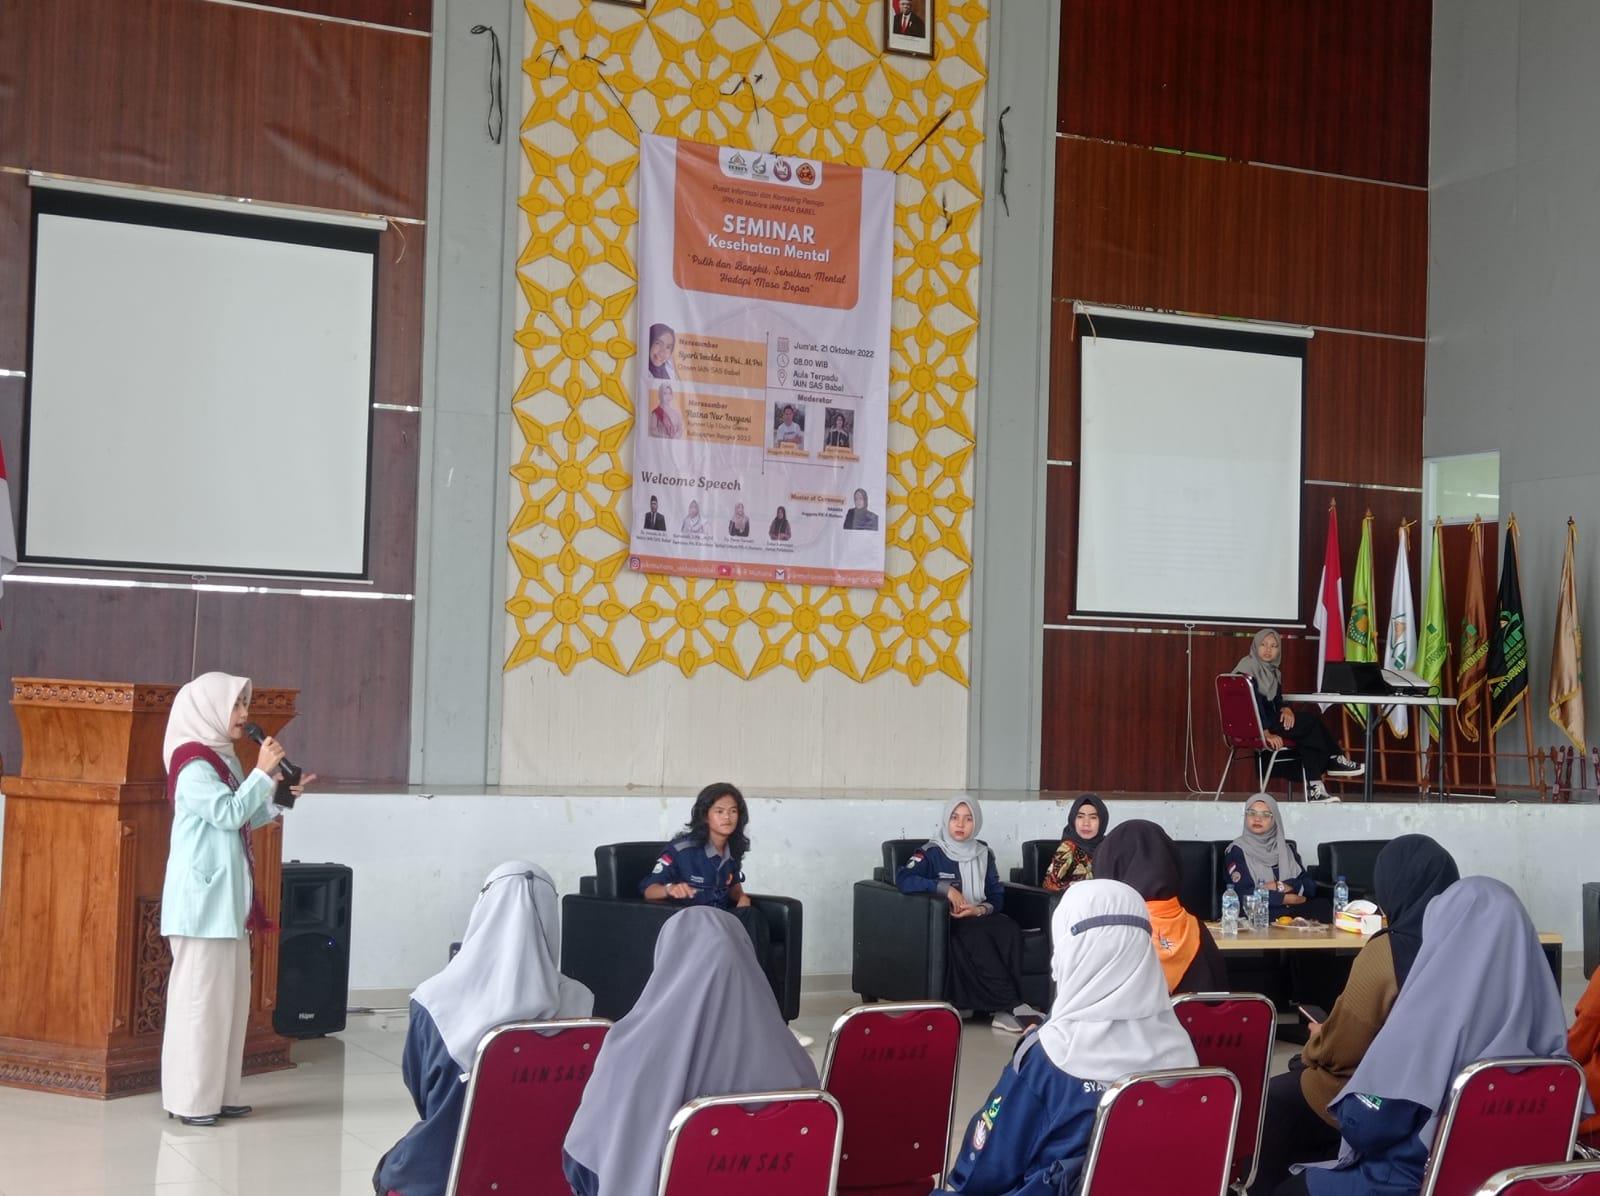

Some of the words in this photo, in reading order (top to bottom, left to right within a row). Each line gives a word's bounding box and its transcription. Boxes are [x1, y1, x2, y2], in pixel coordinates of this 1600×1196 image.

[796, 207, 817, 215] BABEL
[722, 214, 816, 244] SEMINAR
[708, 234, 781, 256] Kesehatan
[784, 245, 830, 263] Mental
[716, 259, 732, 270] dan
[774, 265, 812, 280] Sehatkan
[719, 272, 751, 287] Hadapi
[753, 277, 780, 290] Masa
[820, 344, 829, 352] 21
[829, 345, 857, 356] Oktober
[857, 349, 875, 358] 2022
[815, 359, 829, 369] WIB
[793, 369, 809, 379] Aula
[811, 371, 839, 382] Terpadu
[808, 381, 824, 390] SAS
[797, 394, 833, 404] Moderator
[641, 471, 696, 487] Welcome
[697, 476, 741, 491] Speech
[512, 1064, 551, 1083] IAIN
[706, 1152, 752, 1175] IAIN
[755, 1151, 795, 1173] SAS
